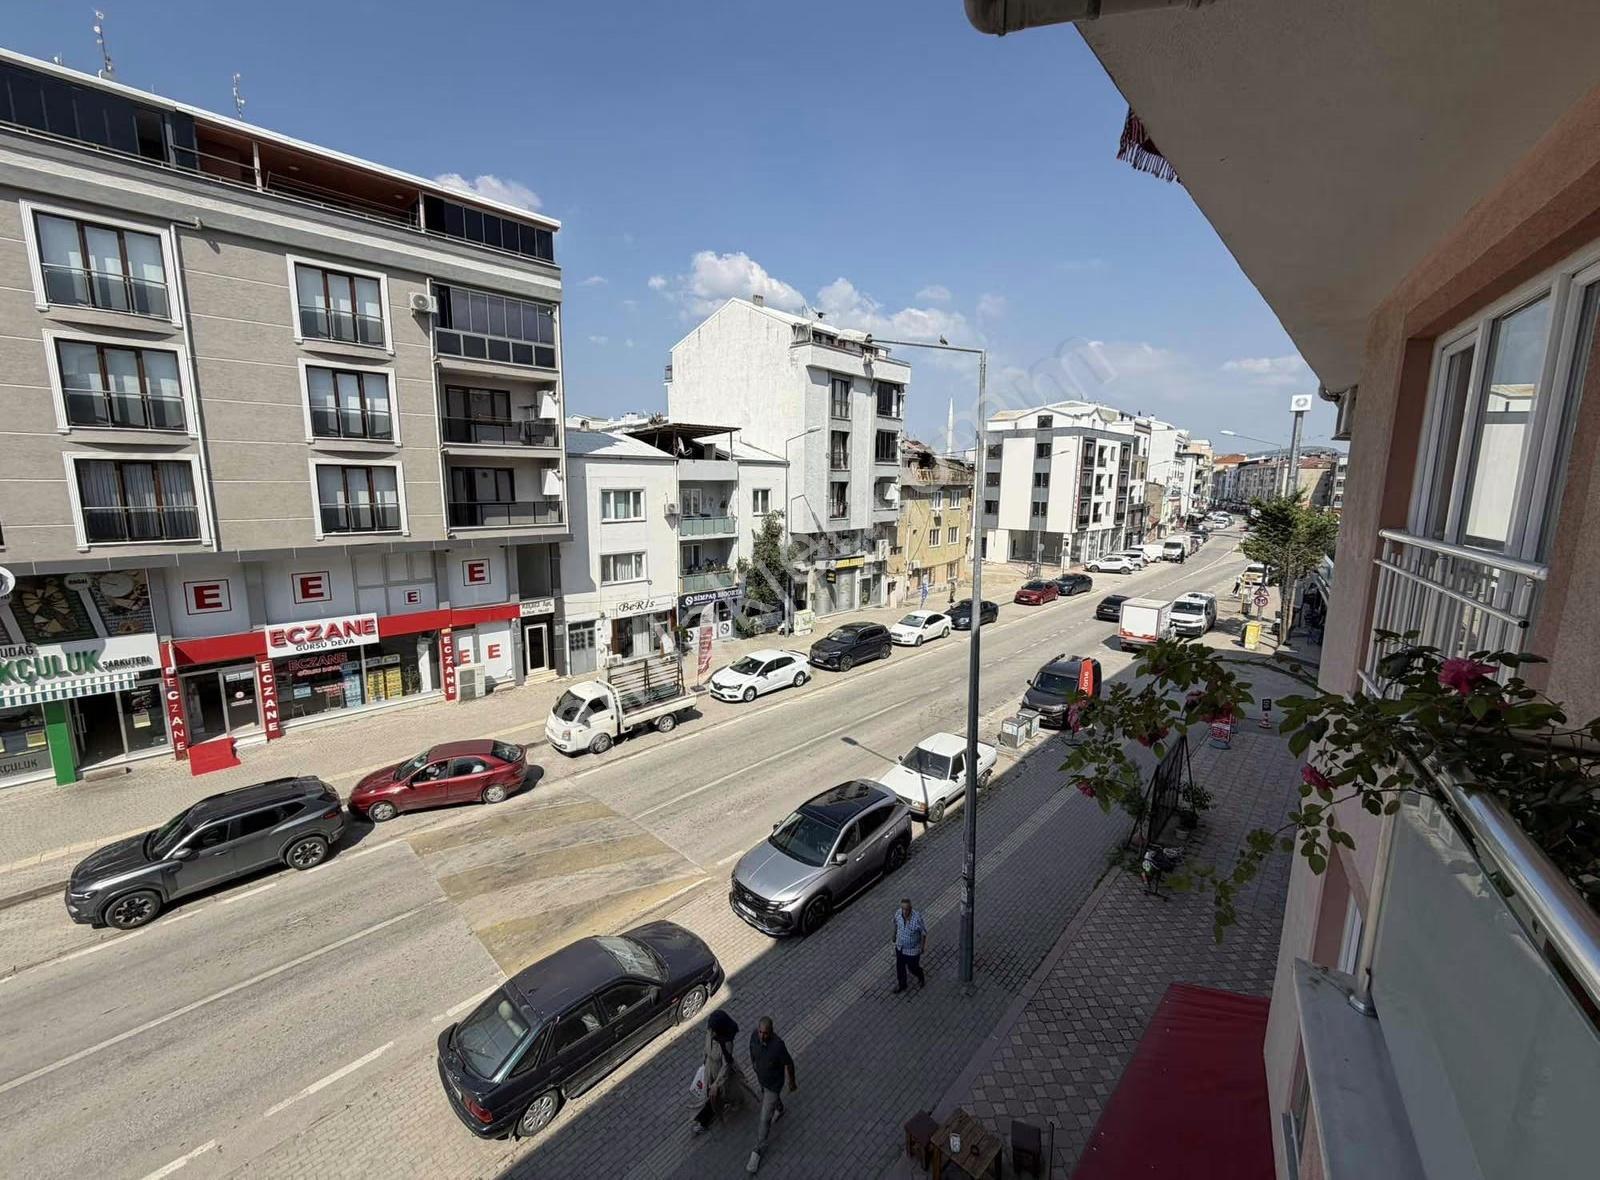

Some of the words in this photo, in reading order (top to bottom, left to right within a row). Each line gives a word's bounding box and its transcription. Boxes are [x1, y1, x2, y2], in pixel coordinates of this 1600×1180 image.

[468, 563, 485, 582] E
[194, 584, 222, 609] E
[300, 576, 324, 599] E
[407, 591, 418, 603] E
[270, 618, 376, 648] ECZANE
[331, 638, 355, 647] DEVA
[458, 649, 471, 665] E
[488, 643, 502, 660] E
[443, 636, 456, 694] ECZANE
[261, 662, 279, 732] ECZANE
[166, 677, 186, 751] ECZANE
